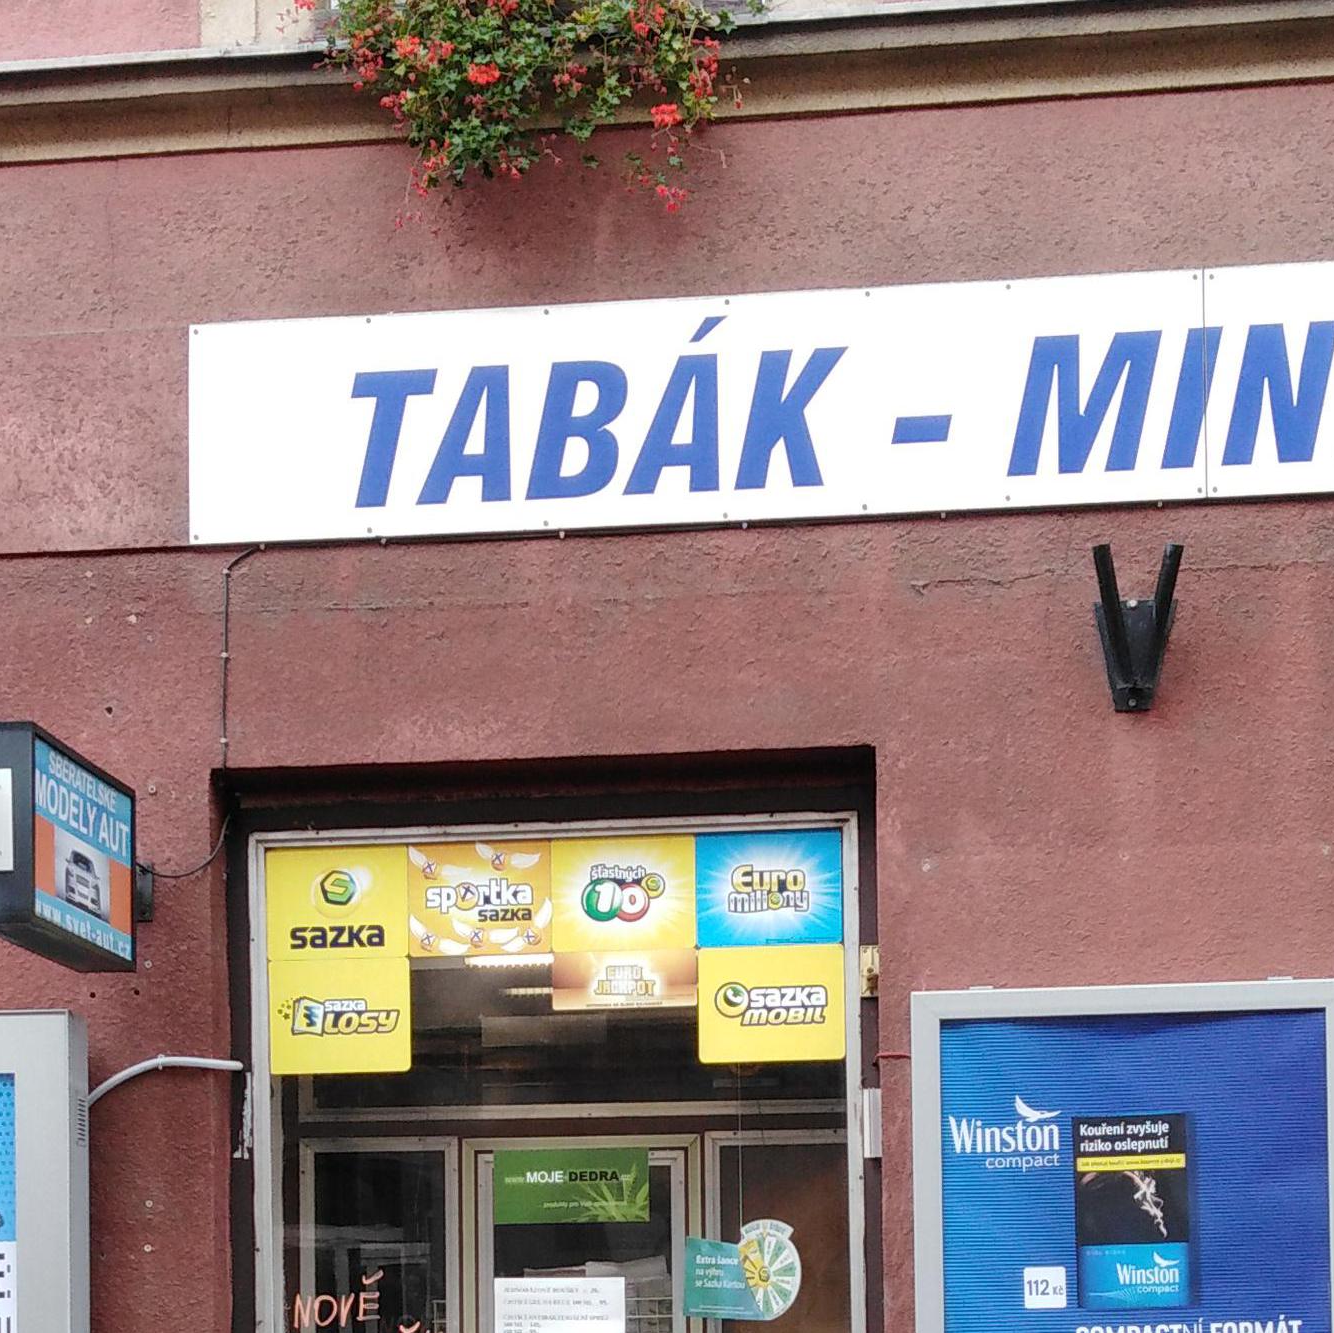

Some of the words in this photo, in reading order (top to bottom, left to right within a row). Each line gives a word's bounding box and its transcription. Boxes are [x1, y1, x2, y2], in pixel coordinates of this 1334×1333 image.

[351, 316, 848, 508] TABÁK
[891, 413, 952, 445] -
[36, 768, 95, 835] MODELY
[99, 818, 130, 858] AUT
[324, 1010, 399, 1034] LOSY
[949, 1114, 1059, 1153] Winston
[1079, 1121, 1124, 1137] Kouření
[1127, 1120, 1169, 1138] zvyšuje
[1080, 1138, 1112, 1152] riziko
[1114, 1135, 1168, 1154] oslepnutí
[985, 1153, 1060, 1172] compact
[1116, 1262, 1179, 1285] Winston
[1026, 1279, 1050, 1296] 112
[1137, 1284, 1179, 1295] compact
